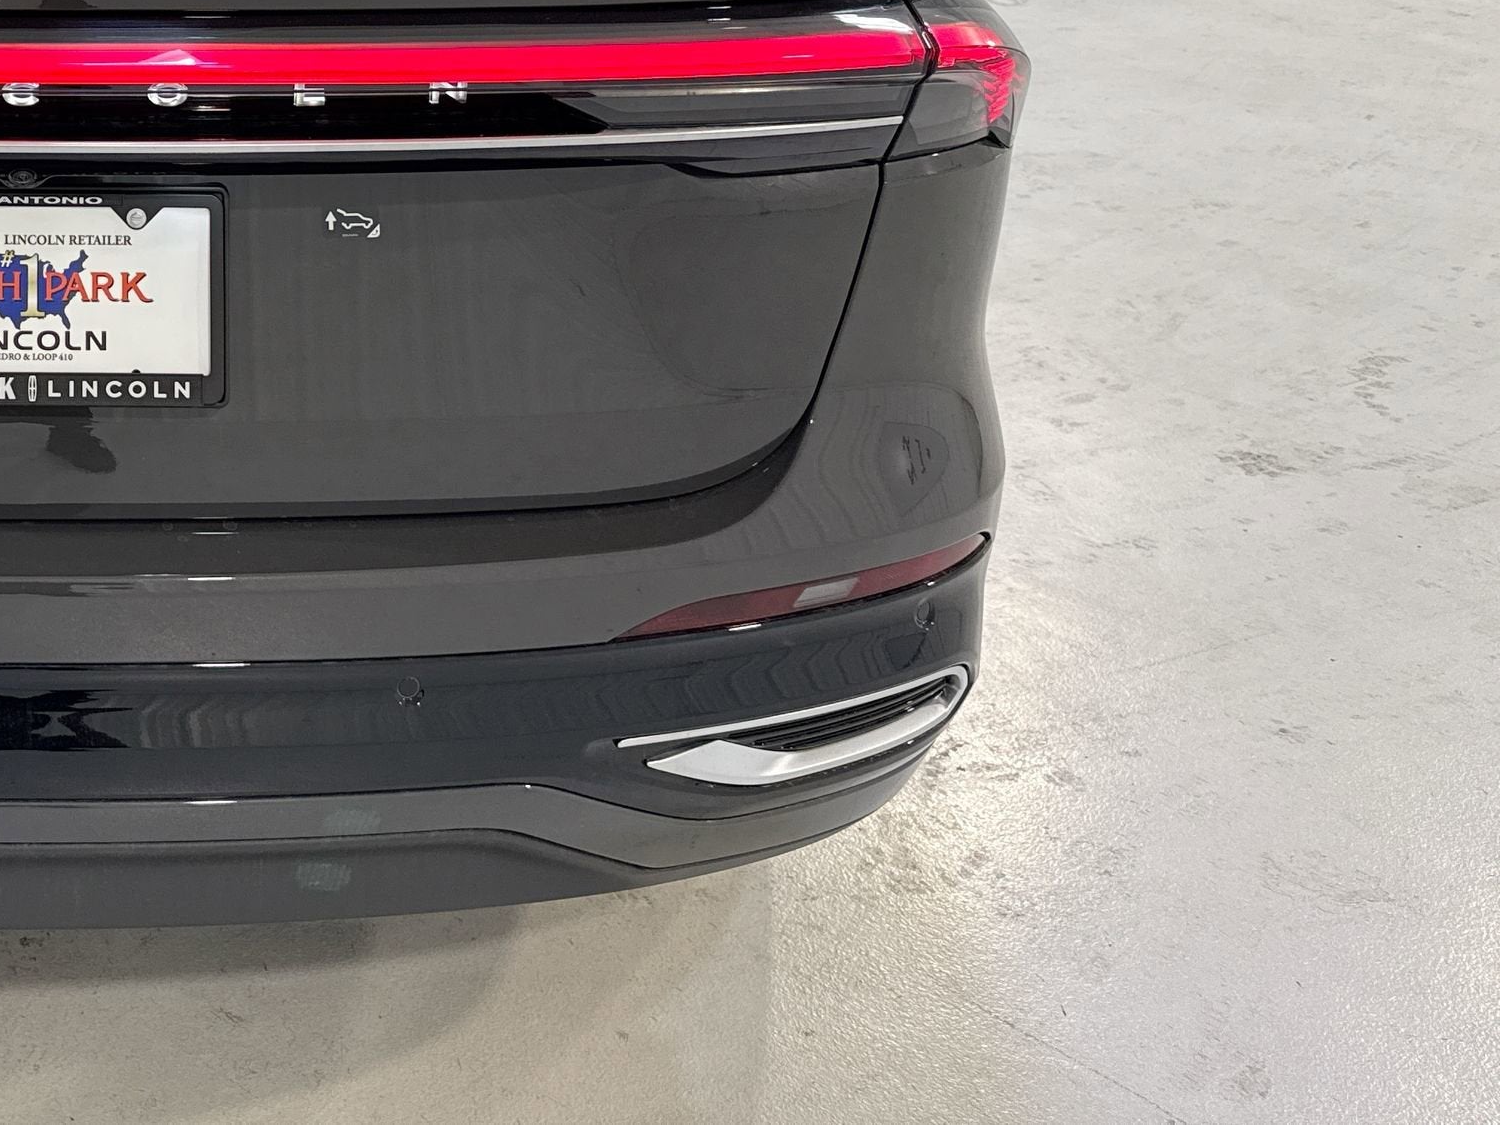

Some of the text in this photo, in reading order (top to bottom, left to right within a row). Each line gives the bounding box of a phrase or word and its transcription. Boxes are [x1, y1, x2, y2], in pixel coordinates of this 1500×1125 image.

[4, 234, 65, 246] LINCOLN
[69, 234, 133, 246] RETAILER
[45, 271, 154, 303] PARK
[23, 353, 31, 361] &
[32, 353, 58, 361] LOOP
[58, 353, 74, 362] 410
[48, 380, 191, 399] LINCOLN
